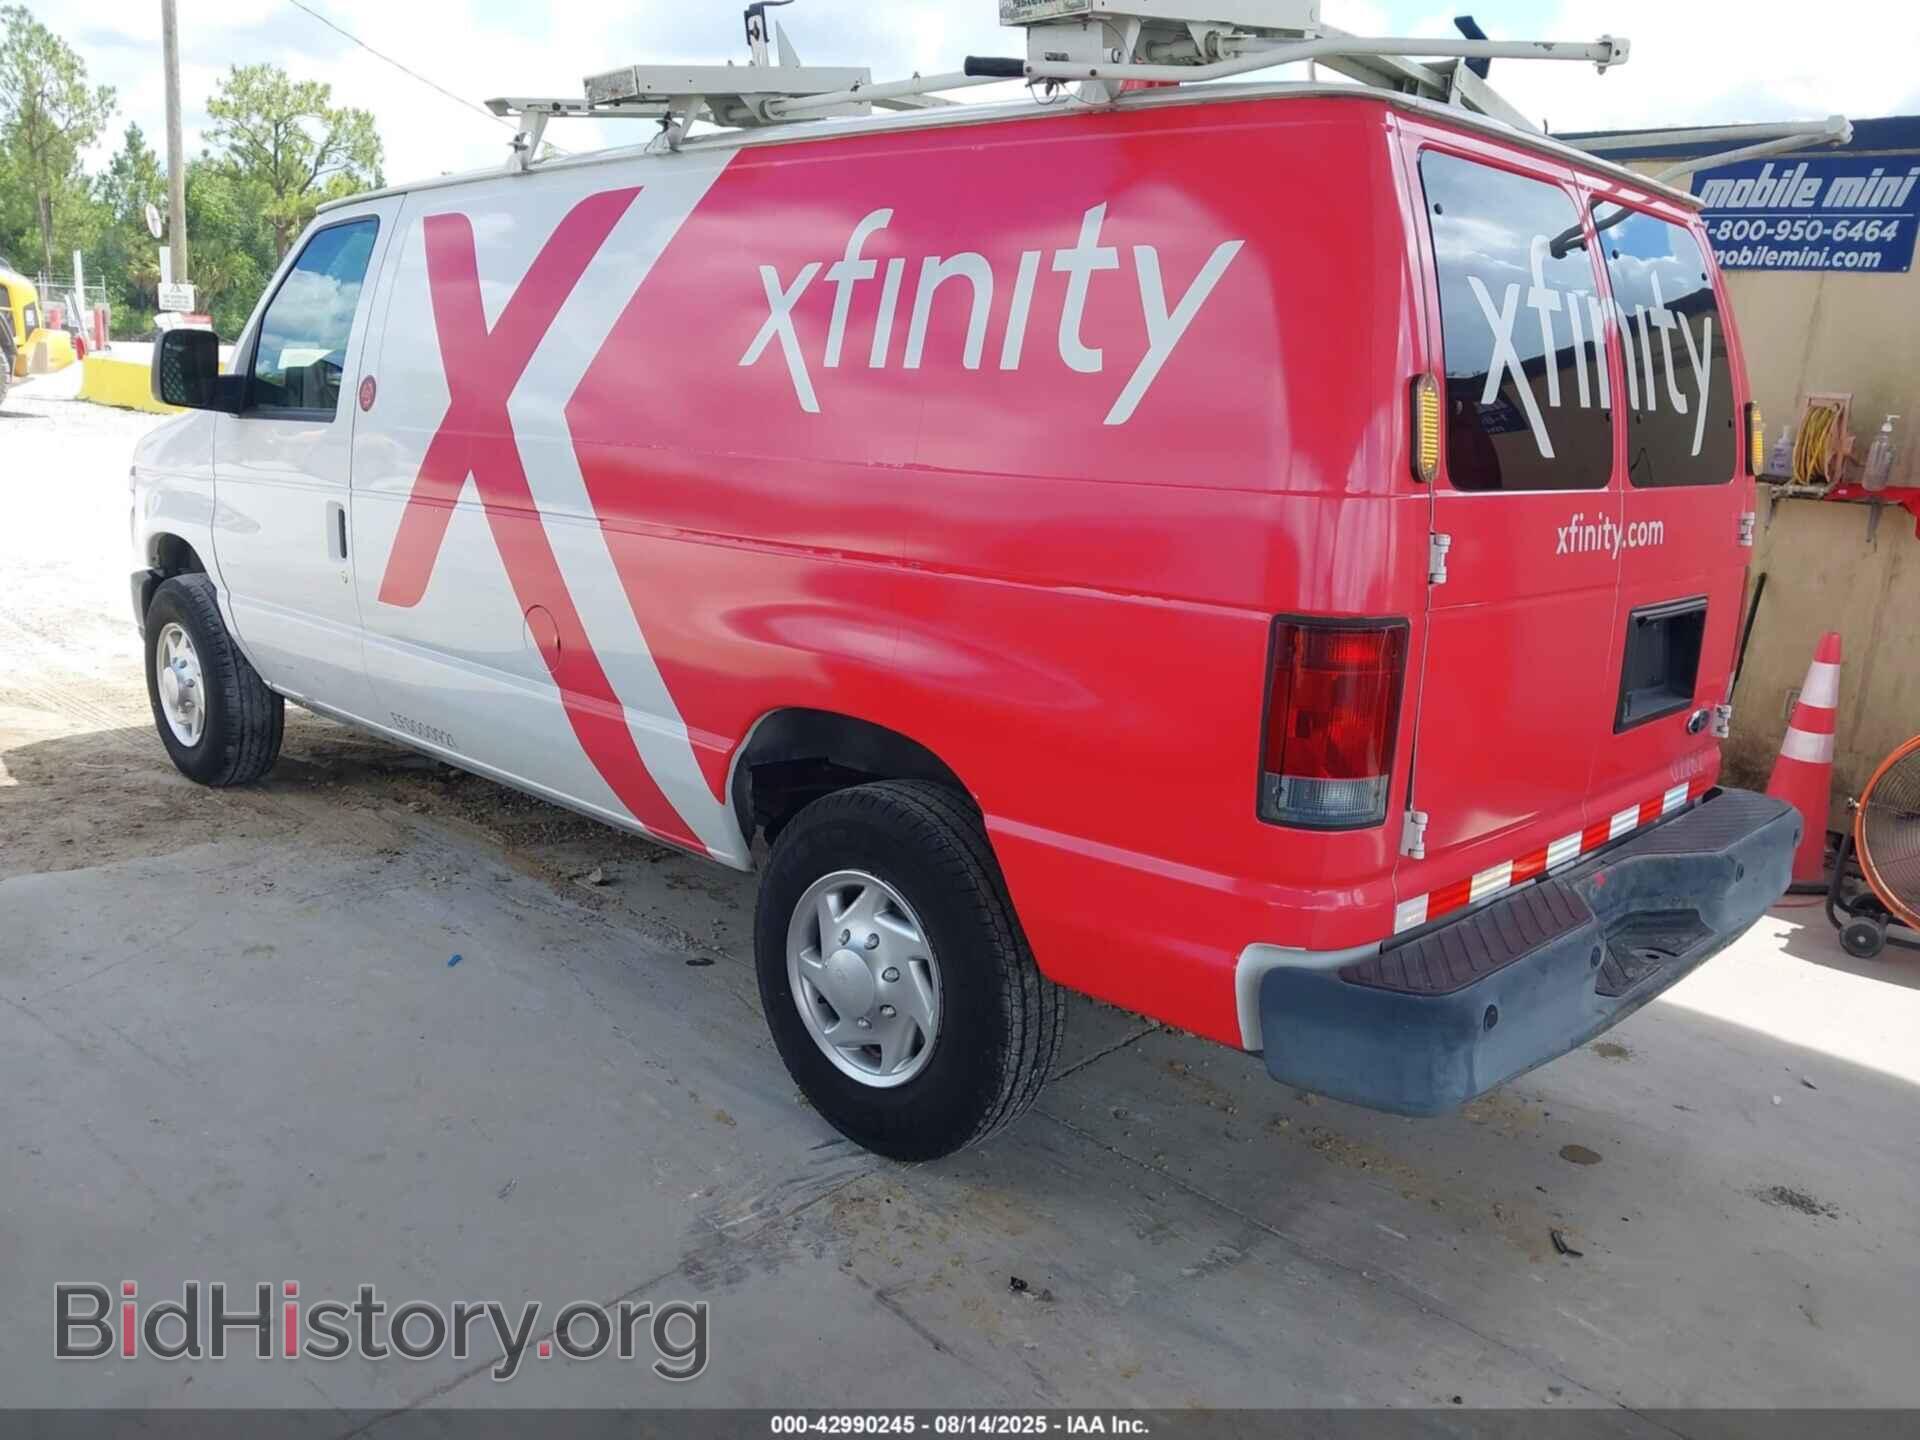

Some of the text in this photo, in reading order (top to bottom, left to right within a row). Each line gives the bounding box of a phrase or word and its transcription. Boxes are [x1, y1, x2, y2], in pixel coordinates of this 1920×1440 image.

[1701, 162, 1920, 208] mobile mini
[738, 201, 1245, 425] xfinity
[1467, 234, 1712, 458] xfinity
[1556, 513, 1664, 560] xfinity.com
